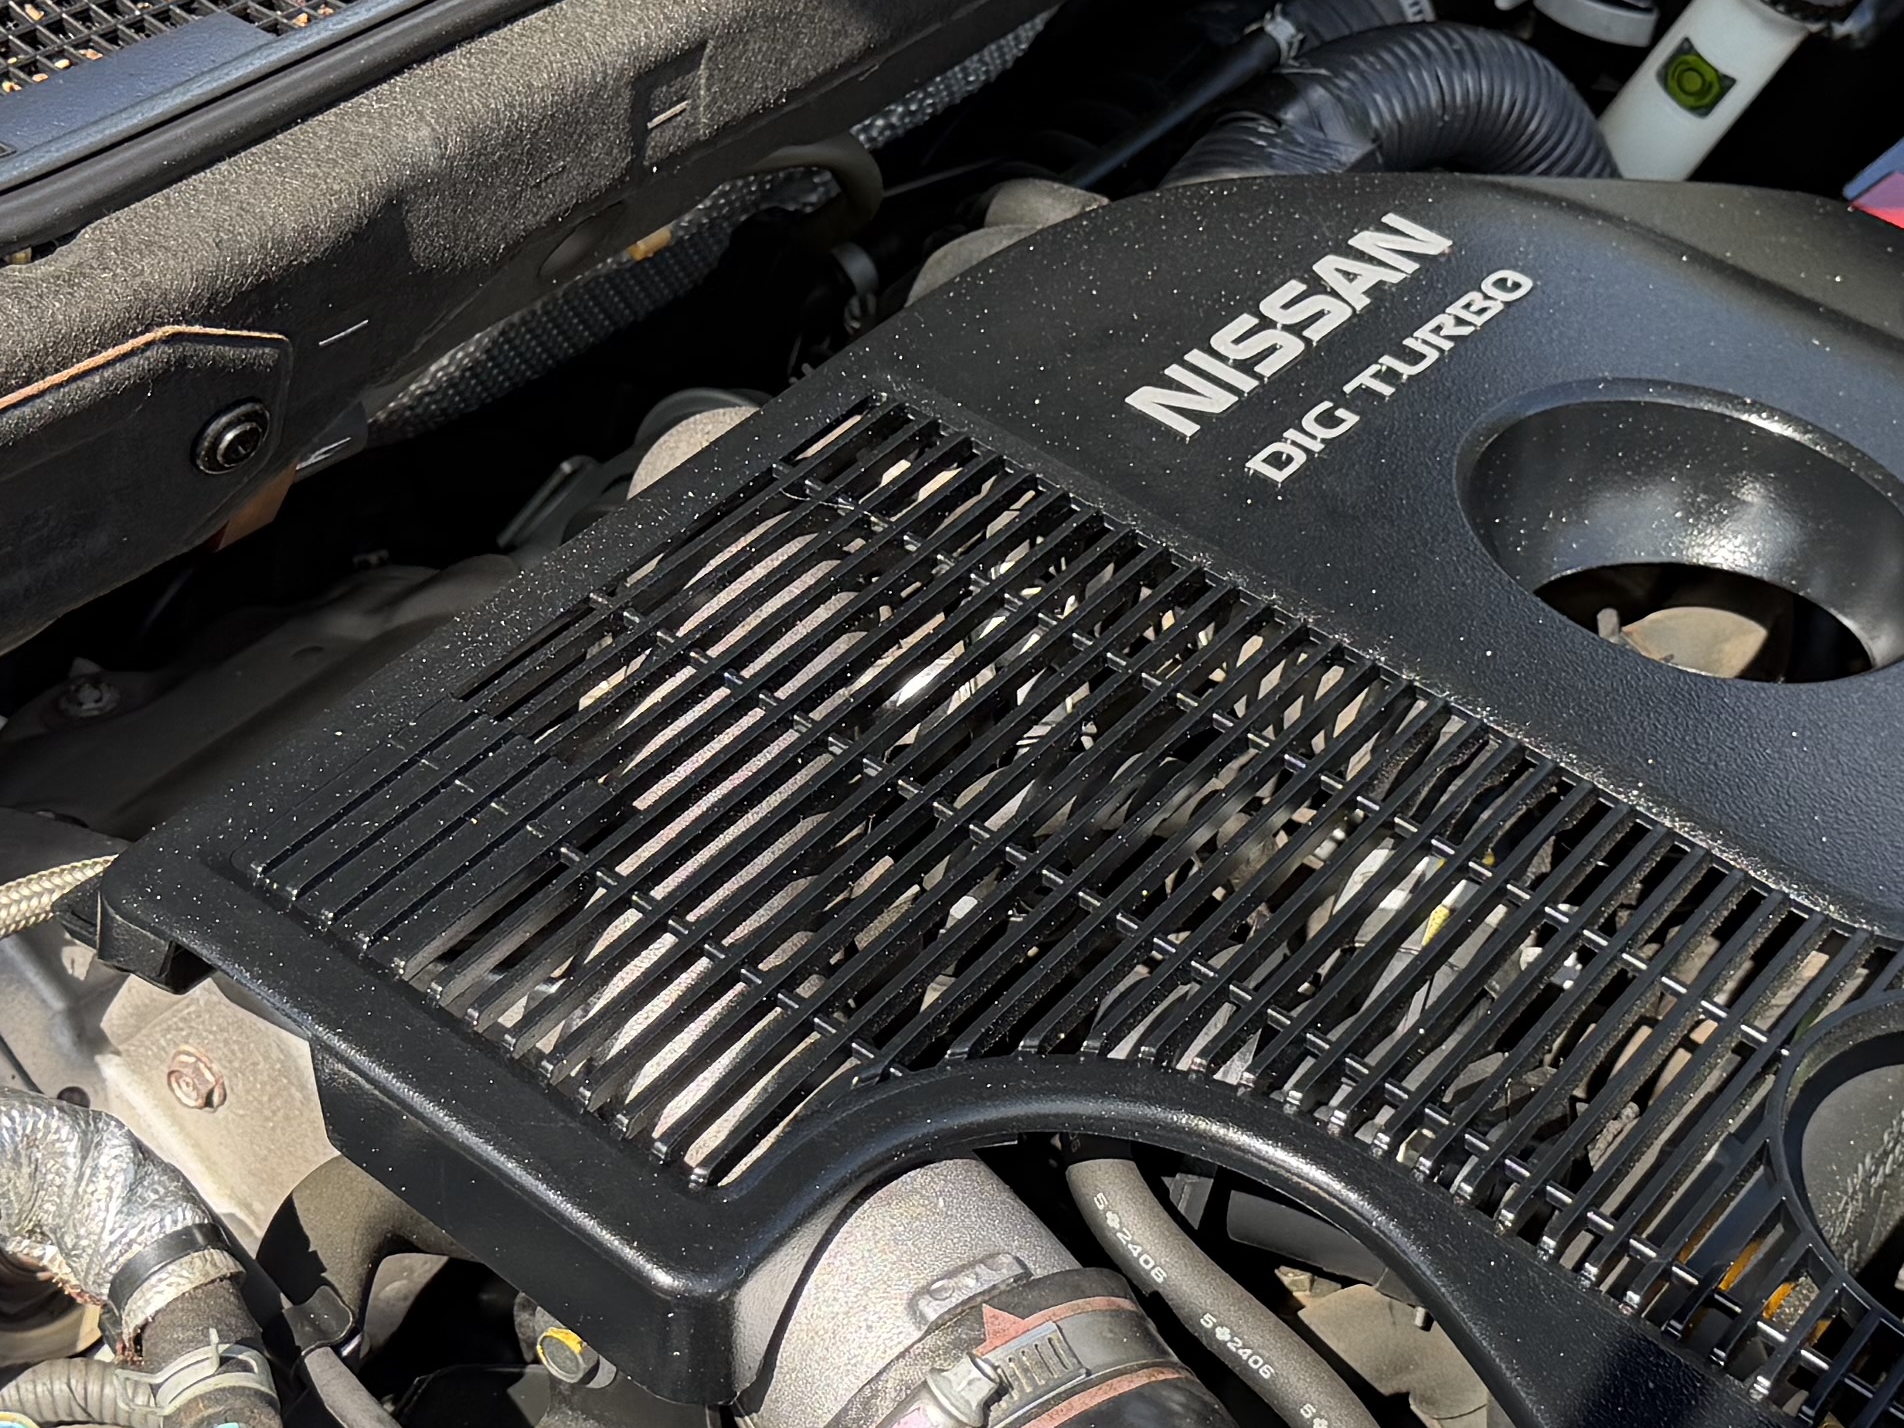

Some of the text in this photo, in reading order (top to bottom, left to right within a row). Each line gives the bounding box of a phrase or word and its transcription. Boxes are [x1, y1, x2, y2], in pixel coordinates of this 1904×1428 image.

[1125, 212, 1453, 439] NISSAN
[1245, 269, 1534, 483] DIG TURBO
